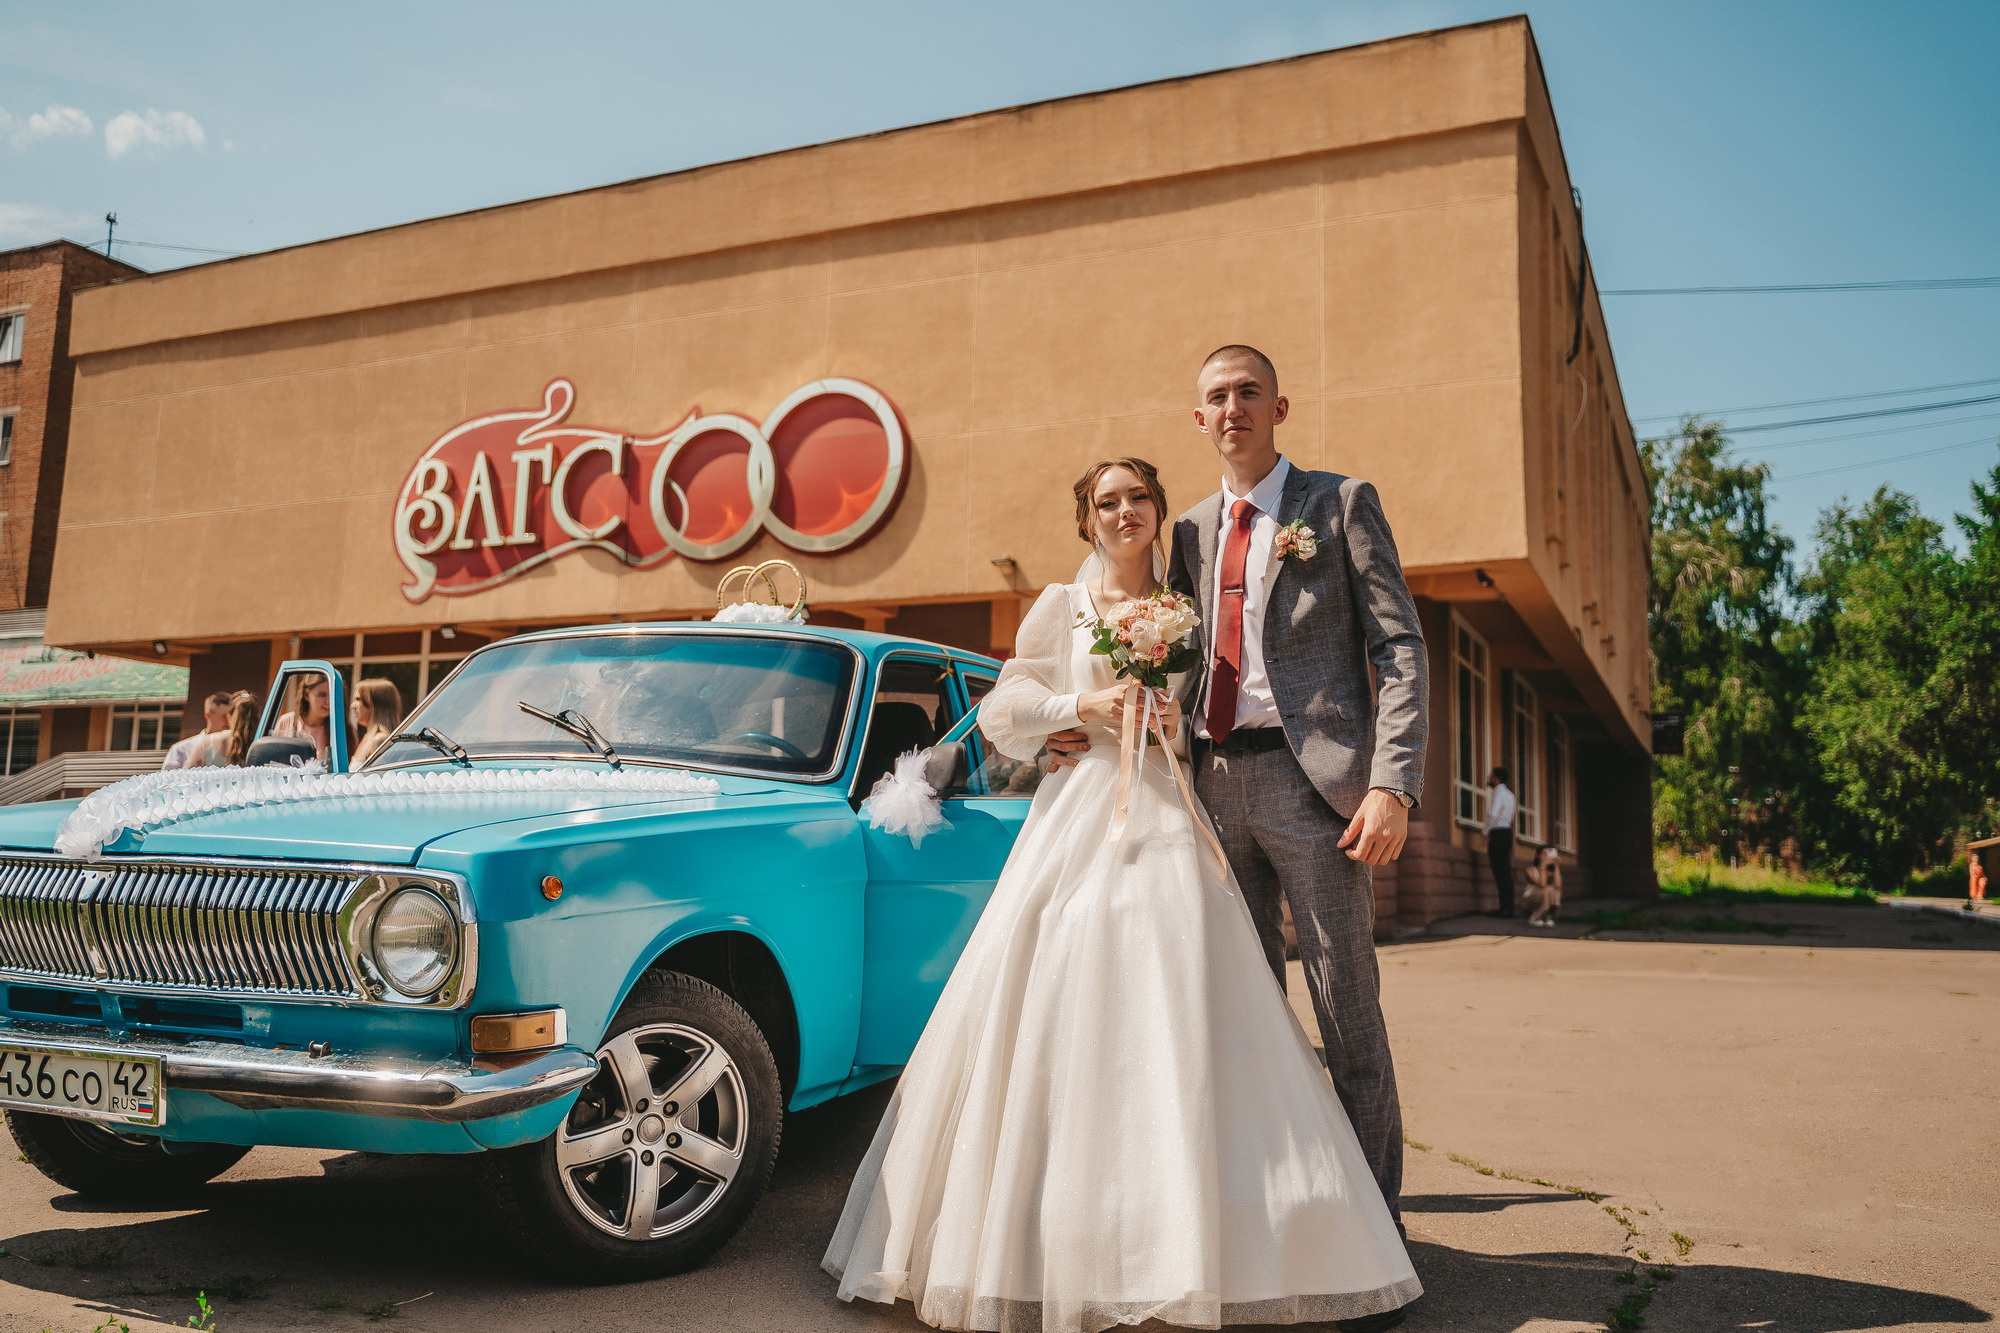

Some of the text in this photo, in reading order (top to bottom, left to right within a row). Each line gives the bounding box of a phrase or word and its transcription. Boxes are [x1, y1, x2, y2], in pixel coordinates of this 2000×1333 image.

[404, 434, 624, 556] ЗАГС
[0, 1052, 147, 1105] 436 CO 42
[112, 1096, 137, 1111] RUS
